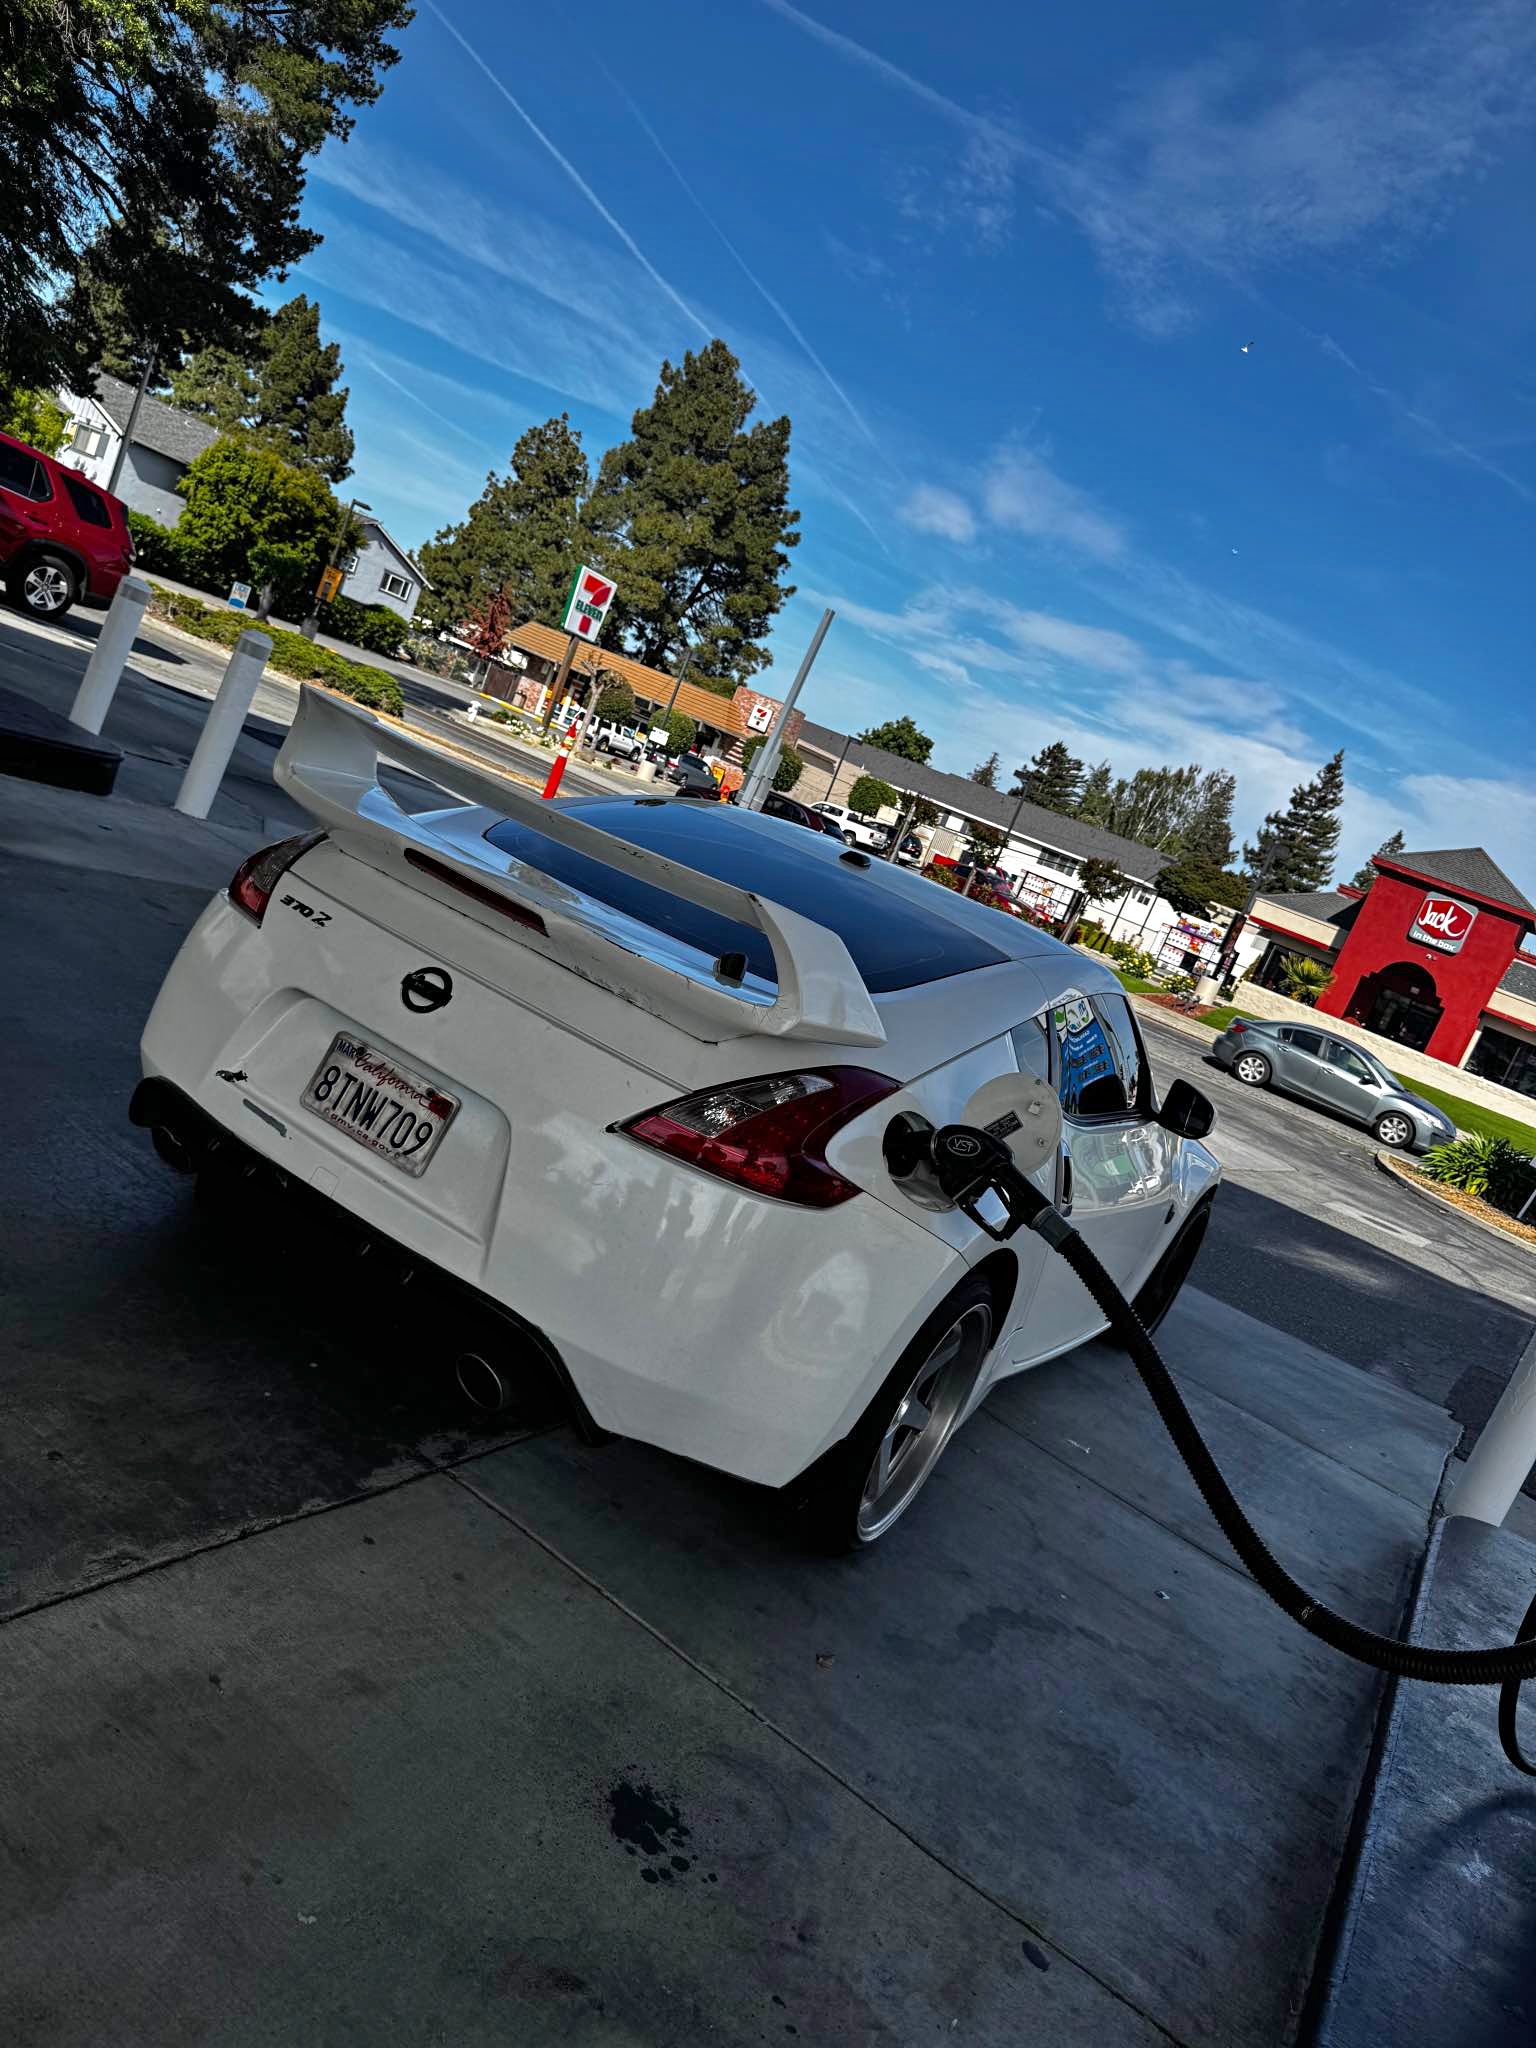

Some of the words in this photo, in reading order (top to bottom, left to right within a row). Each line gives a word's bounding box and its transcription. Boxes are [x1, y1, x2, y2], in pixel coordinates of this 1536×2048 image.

[583, 573, 612, 608] 7
[280, 895, 333, 927] 370Z
[1418, 901, 1466, 937] Jack
[1413, 930, 1424, 939] in
[1423, 934, 1438, 946] the
[1439, 940, 1457, 952] box
[355, 1052, 431, 1107] California
[314, 1065, 433, 1156] 8TNW709
